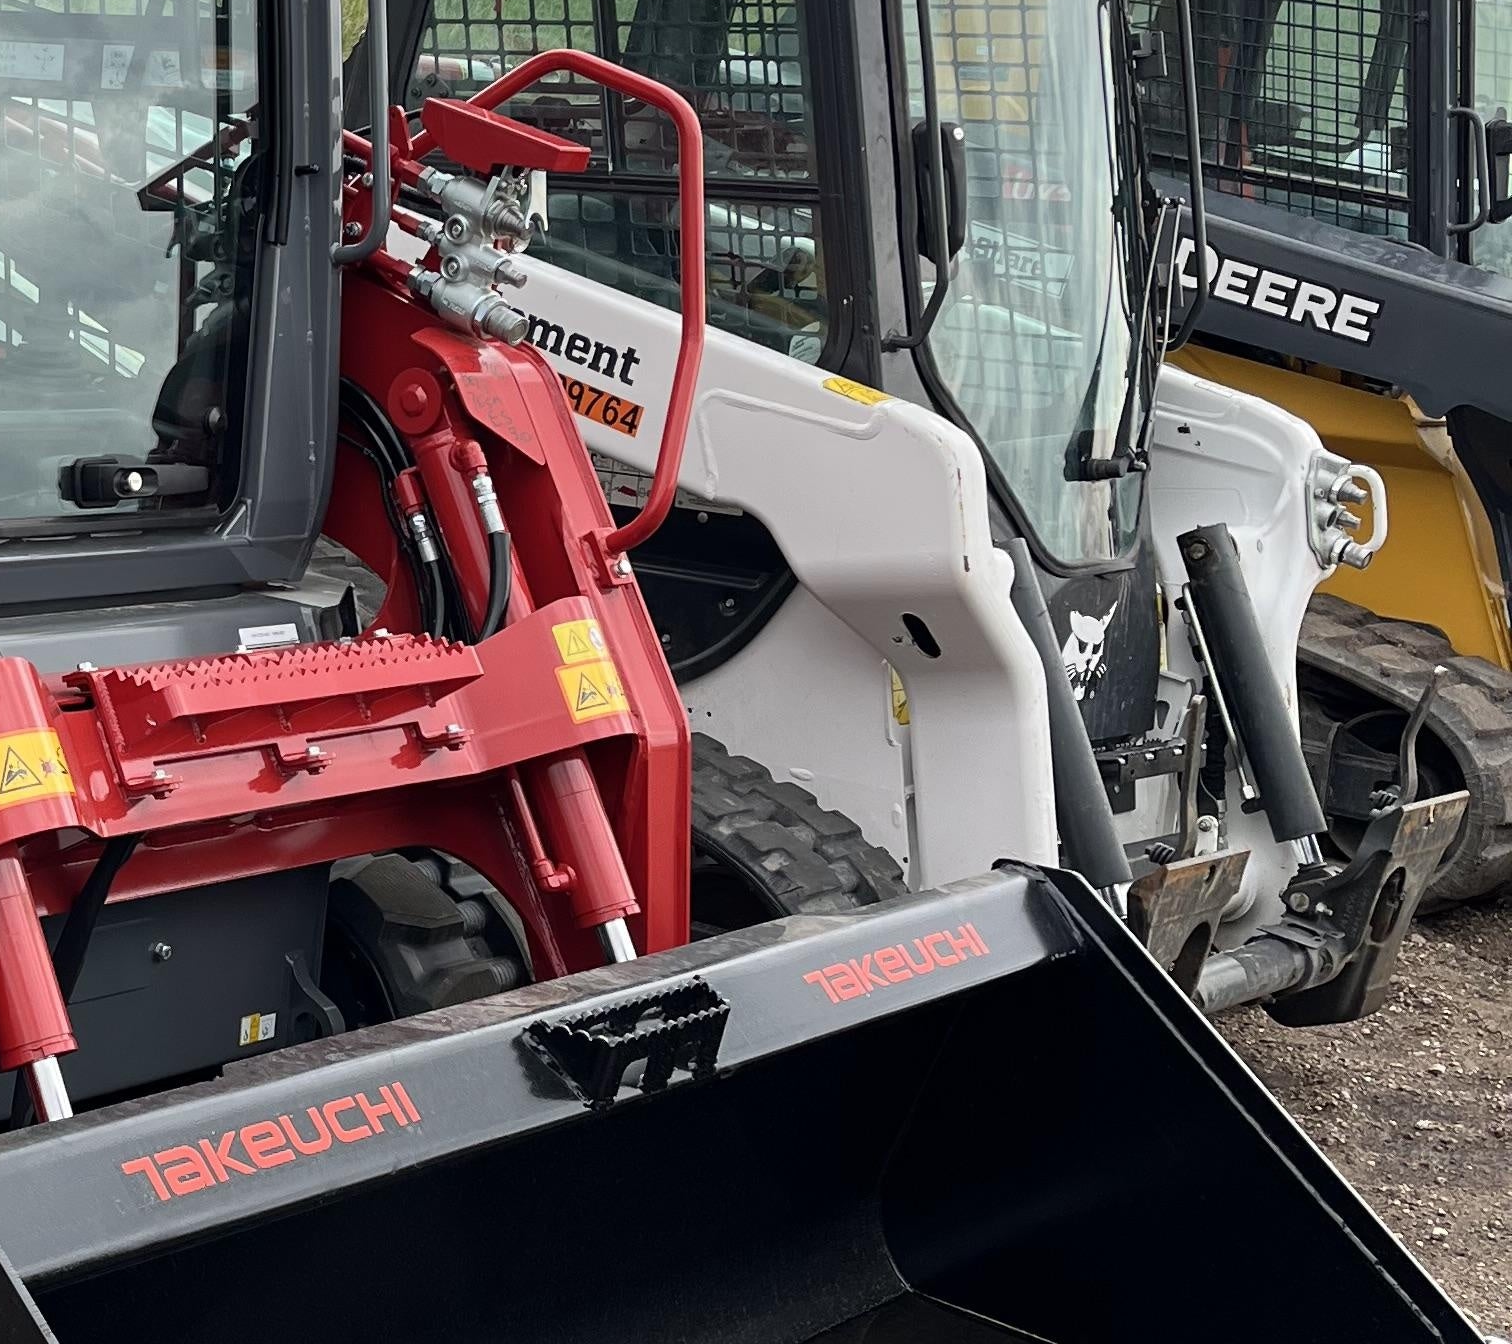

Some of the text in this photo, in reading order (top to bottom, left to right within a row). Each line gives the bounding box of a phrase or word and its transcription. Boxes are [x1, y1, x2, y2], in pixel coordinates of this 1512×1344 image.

[1175, 237, 1380, 342] DEERE
[511, 307, 641, 387] ment
[803, 922, 990, 1005] TAKEUCHI
[122, 1080, 422, 1202] TAKEUCHI
